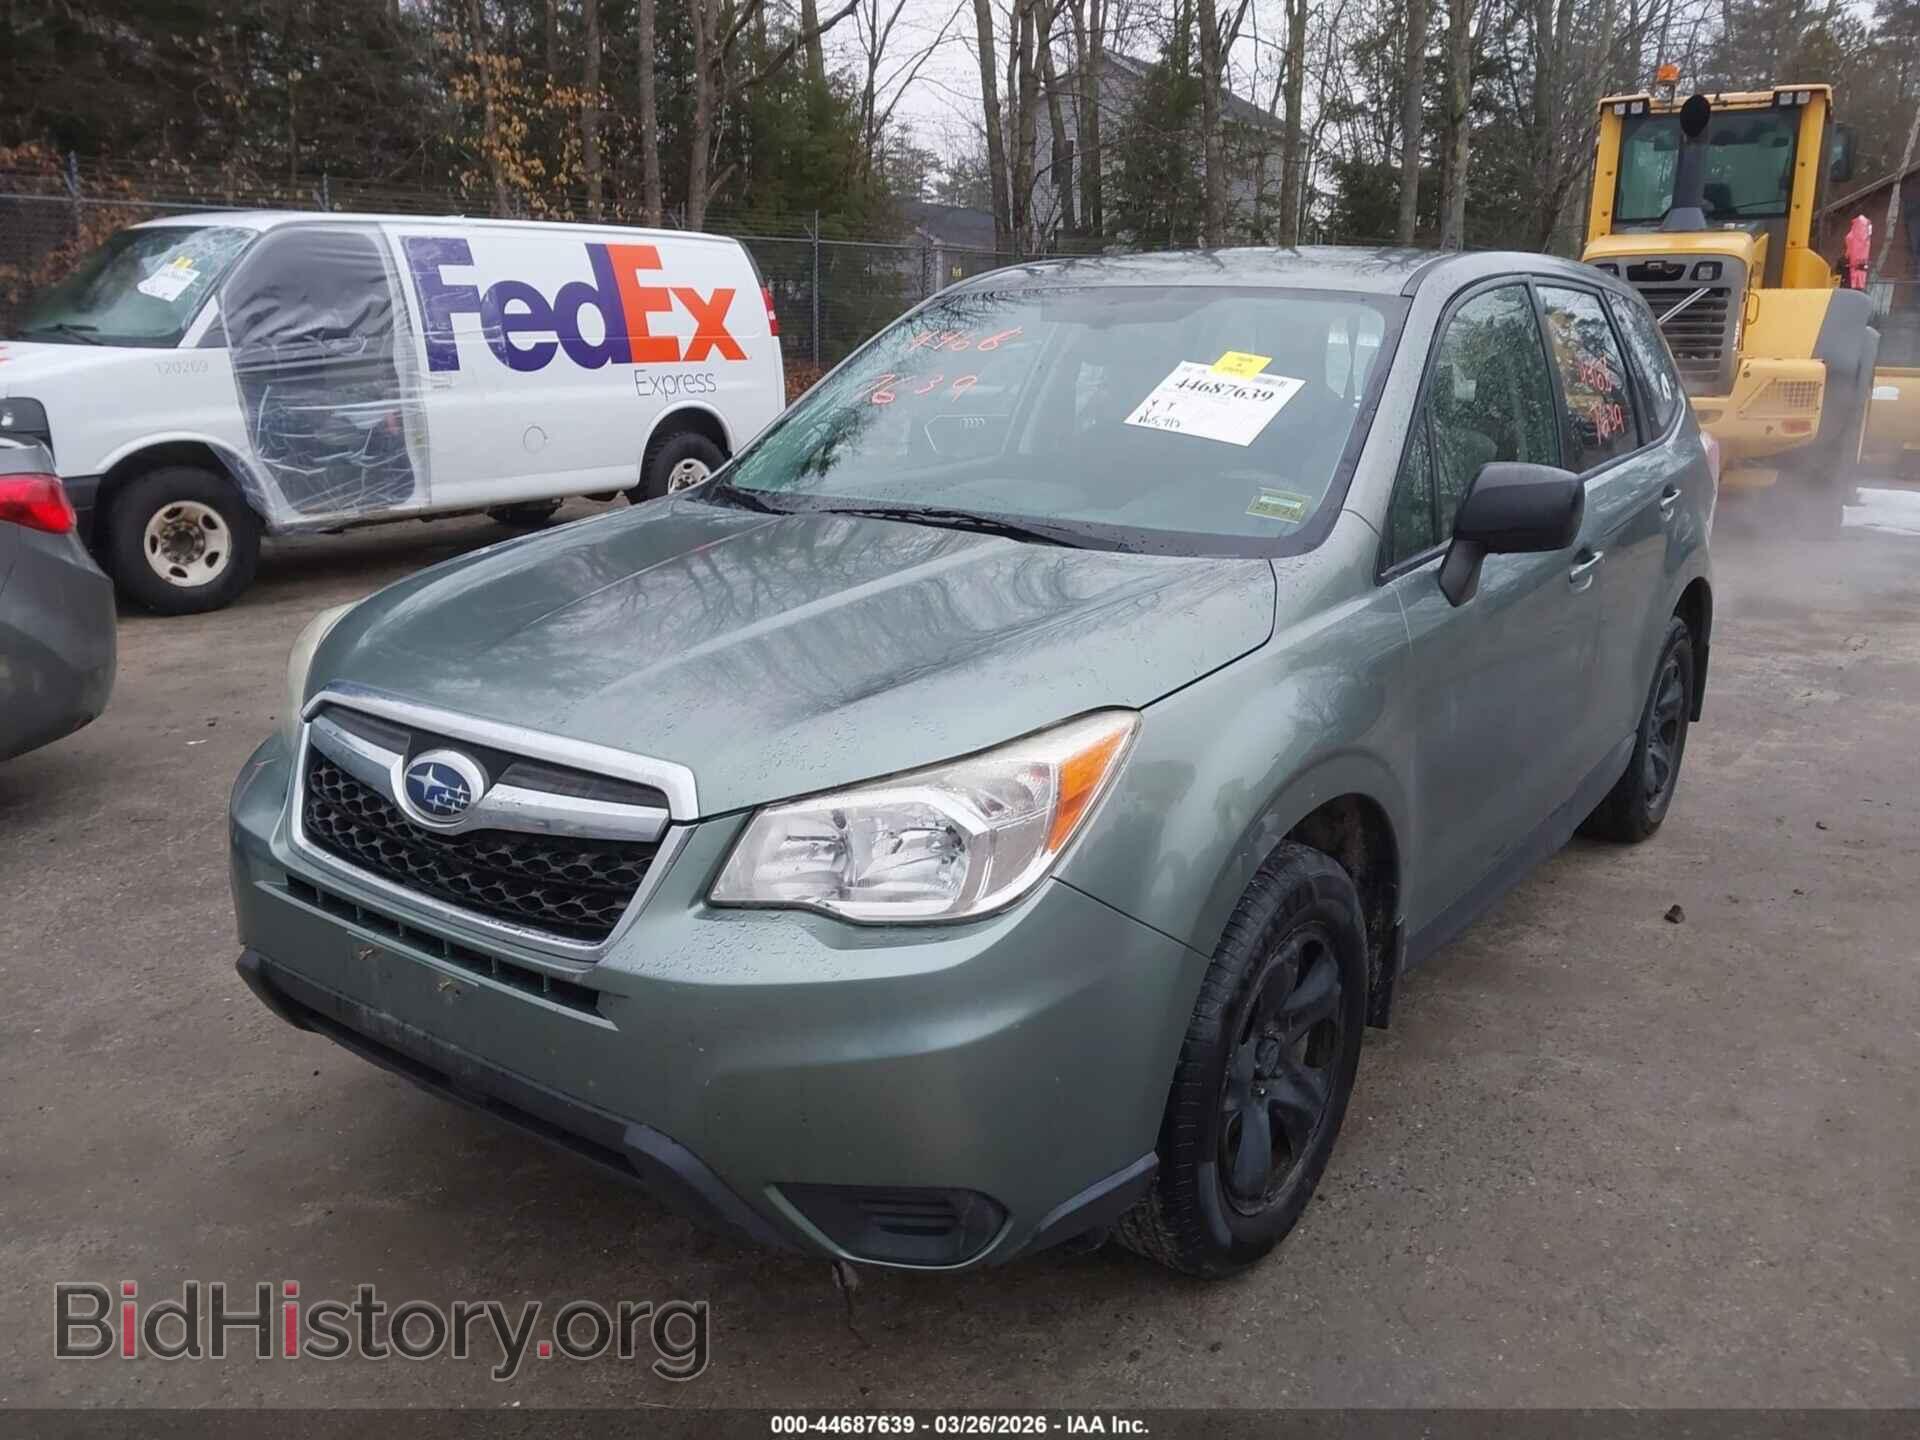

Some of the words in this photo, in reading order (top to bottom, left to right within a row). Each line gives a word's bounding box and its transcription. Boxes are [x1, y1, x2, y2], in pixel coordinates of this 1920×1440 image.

[400, 237, 749, 373] FedEx
[633, 369, 717, 401] Express
[1175, 377, 1275, 402] 44687639
